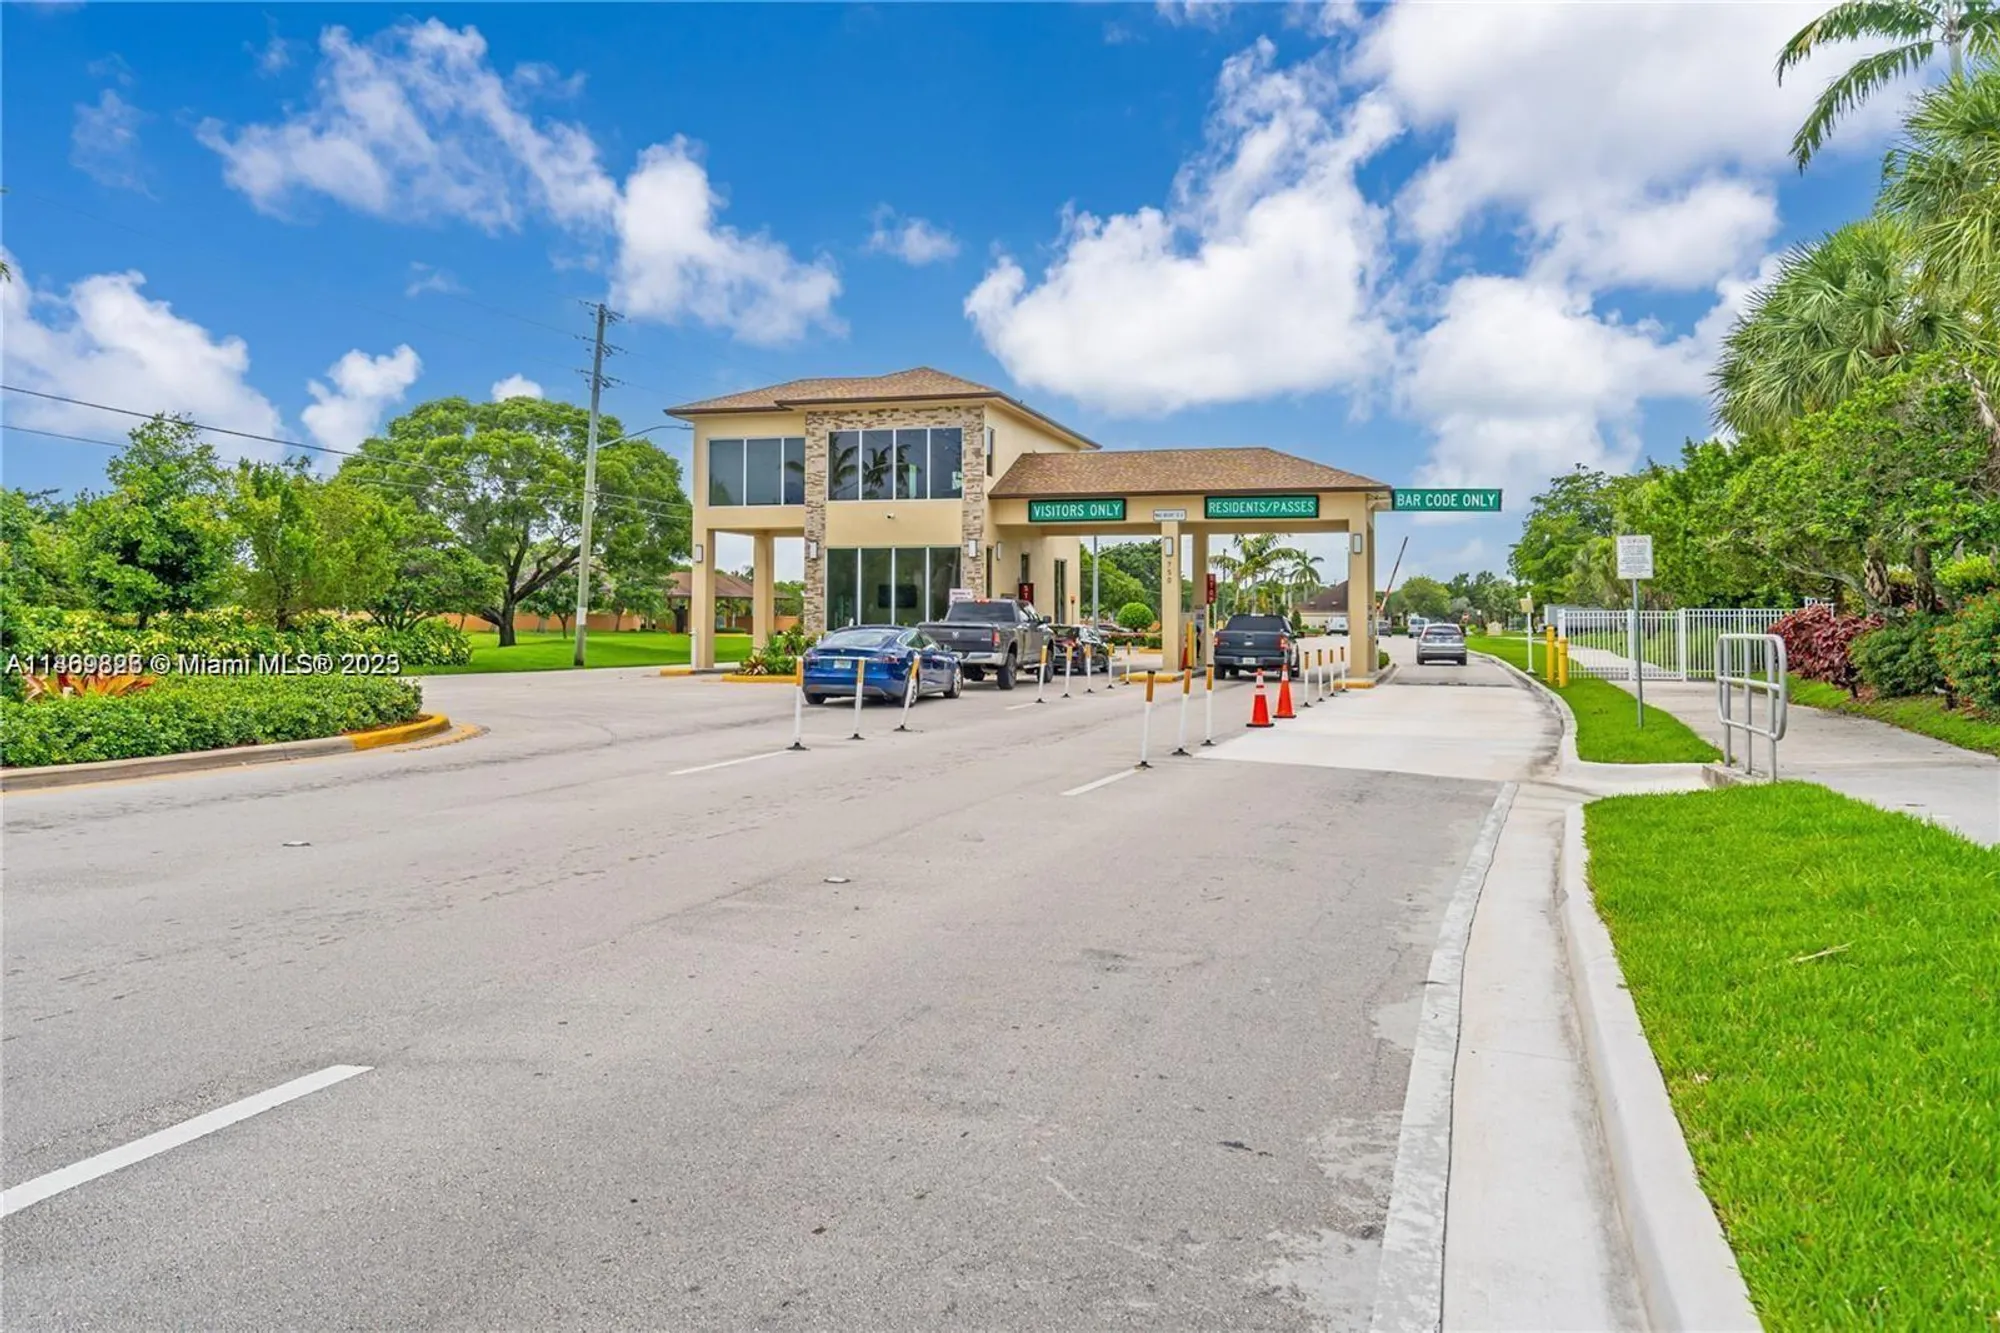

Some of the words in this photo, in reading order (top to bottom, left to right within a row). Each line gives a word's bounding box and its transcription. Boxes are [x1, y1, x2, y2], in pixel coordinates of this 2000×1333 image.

[1208, 500, 1315, 514] RESIDENTS/PASSES
[1397, 494, 1421, 507] BAR
[1425, 494, 1458, 507] CODE
[1462, 494, 1496, 507] ONLY
[1033, 504, 1085, 517] VISITORS
[1089, 503, 1121, 516] ONLY
